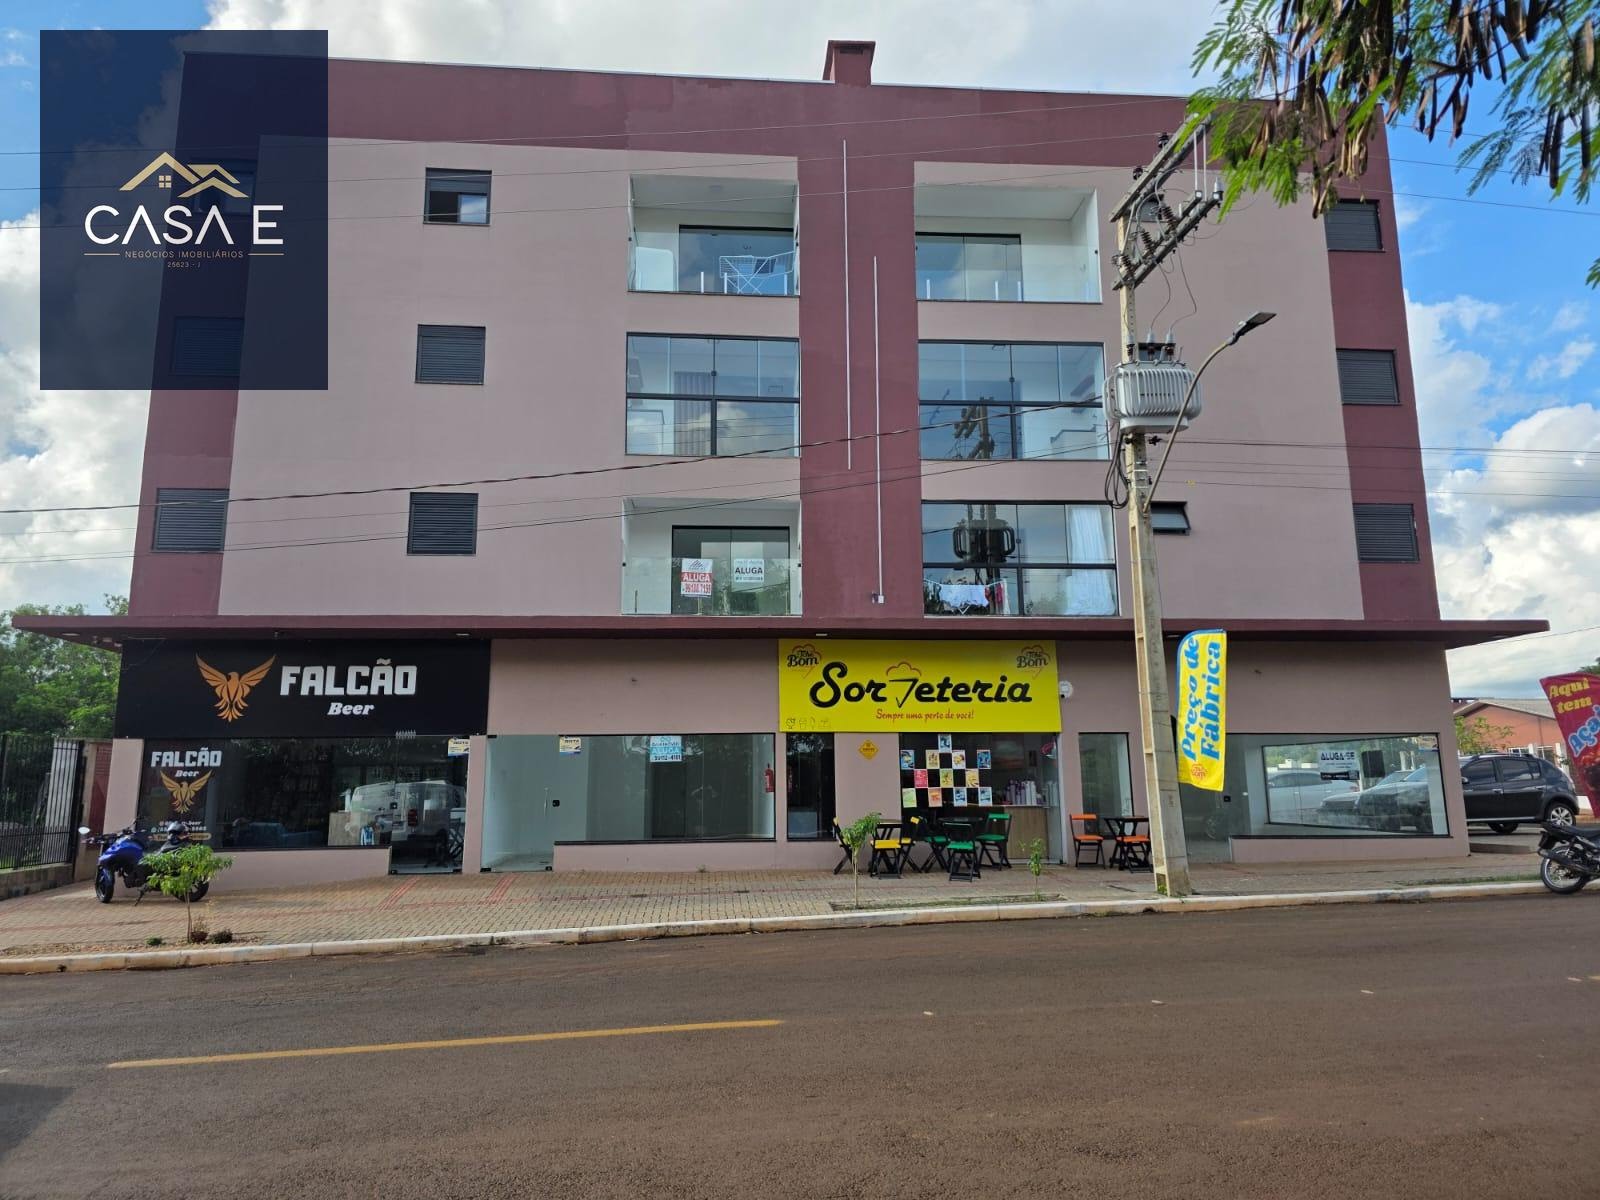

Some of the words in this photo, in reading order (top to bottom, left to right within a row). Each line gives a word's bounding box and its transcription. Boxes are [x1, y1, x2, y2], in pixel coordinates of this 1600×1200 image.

[682, 572, 711, 582] ALUGA
[735, 567, 763, 575] ALUGA
[786, 655, 819, 667] Bom
[1016, 656, 1049, 668] Bom
[1185, 637, 1199, 669] de
[280, 658, 418, 696] FALCÃO
[1549, 677, 1591, 699] Aqui
[327, 702, 375, 716] Beer
[1200, 642, 1221, 760] Fábrica
[1556, 697, 1592, 714] tem
[1182, 676, 1202, 761] Preço
[151, 747, 222, 767] FALCÃO
